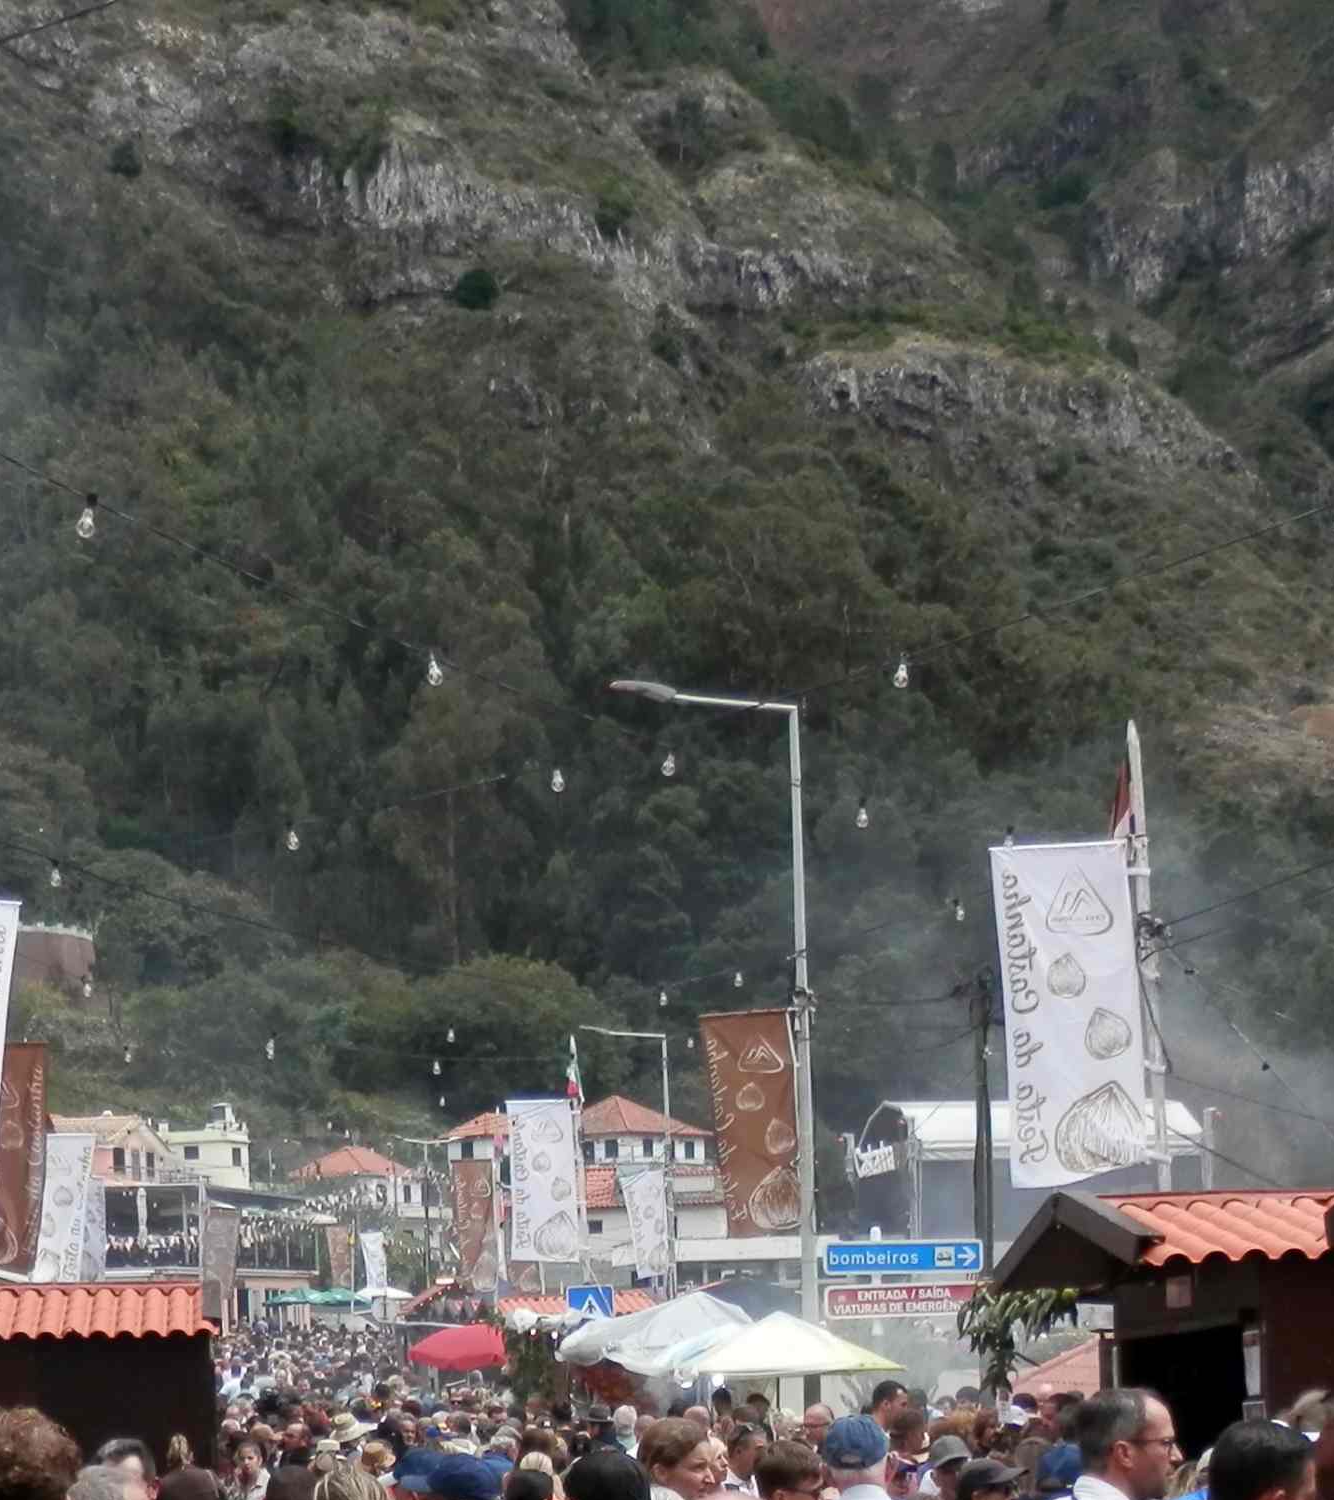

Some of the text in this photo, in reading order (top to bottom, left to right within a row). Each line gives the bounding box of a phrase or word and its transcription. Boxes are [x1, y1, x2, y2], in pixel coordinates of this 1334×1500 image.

[829, 1250, 919, 1265] bombeiros
[858, 1290, 907, 1302] ENTRADA
[919, 1287, 951, 1299] SAÍDA
[834, 1302, 888, 1315] VIATURAS
[889, 1302, 904, 1313] DE
